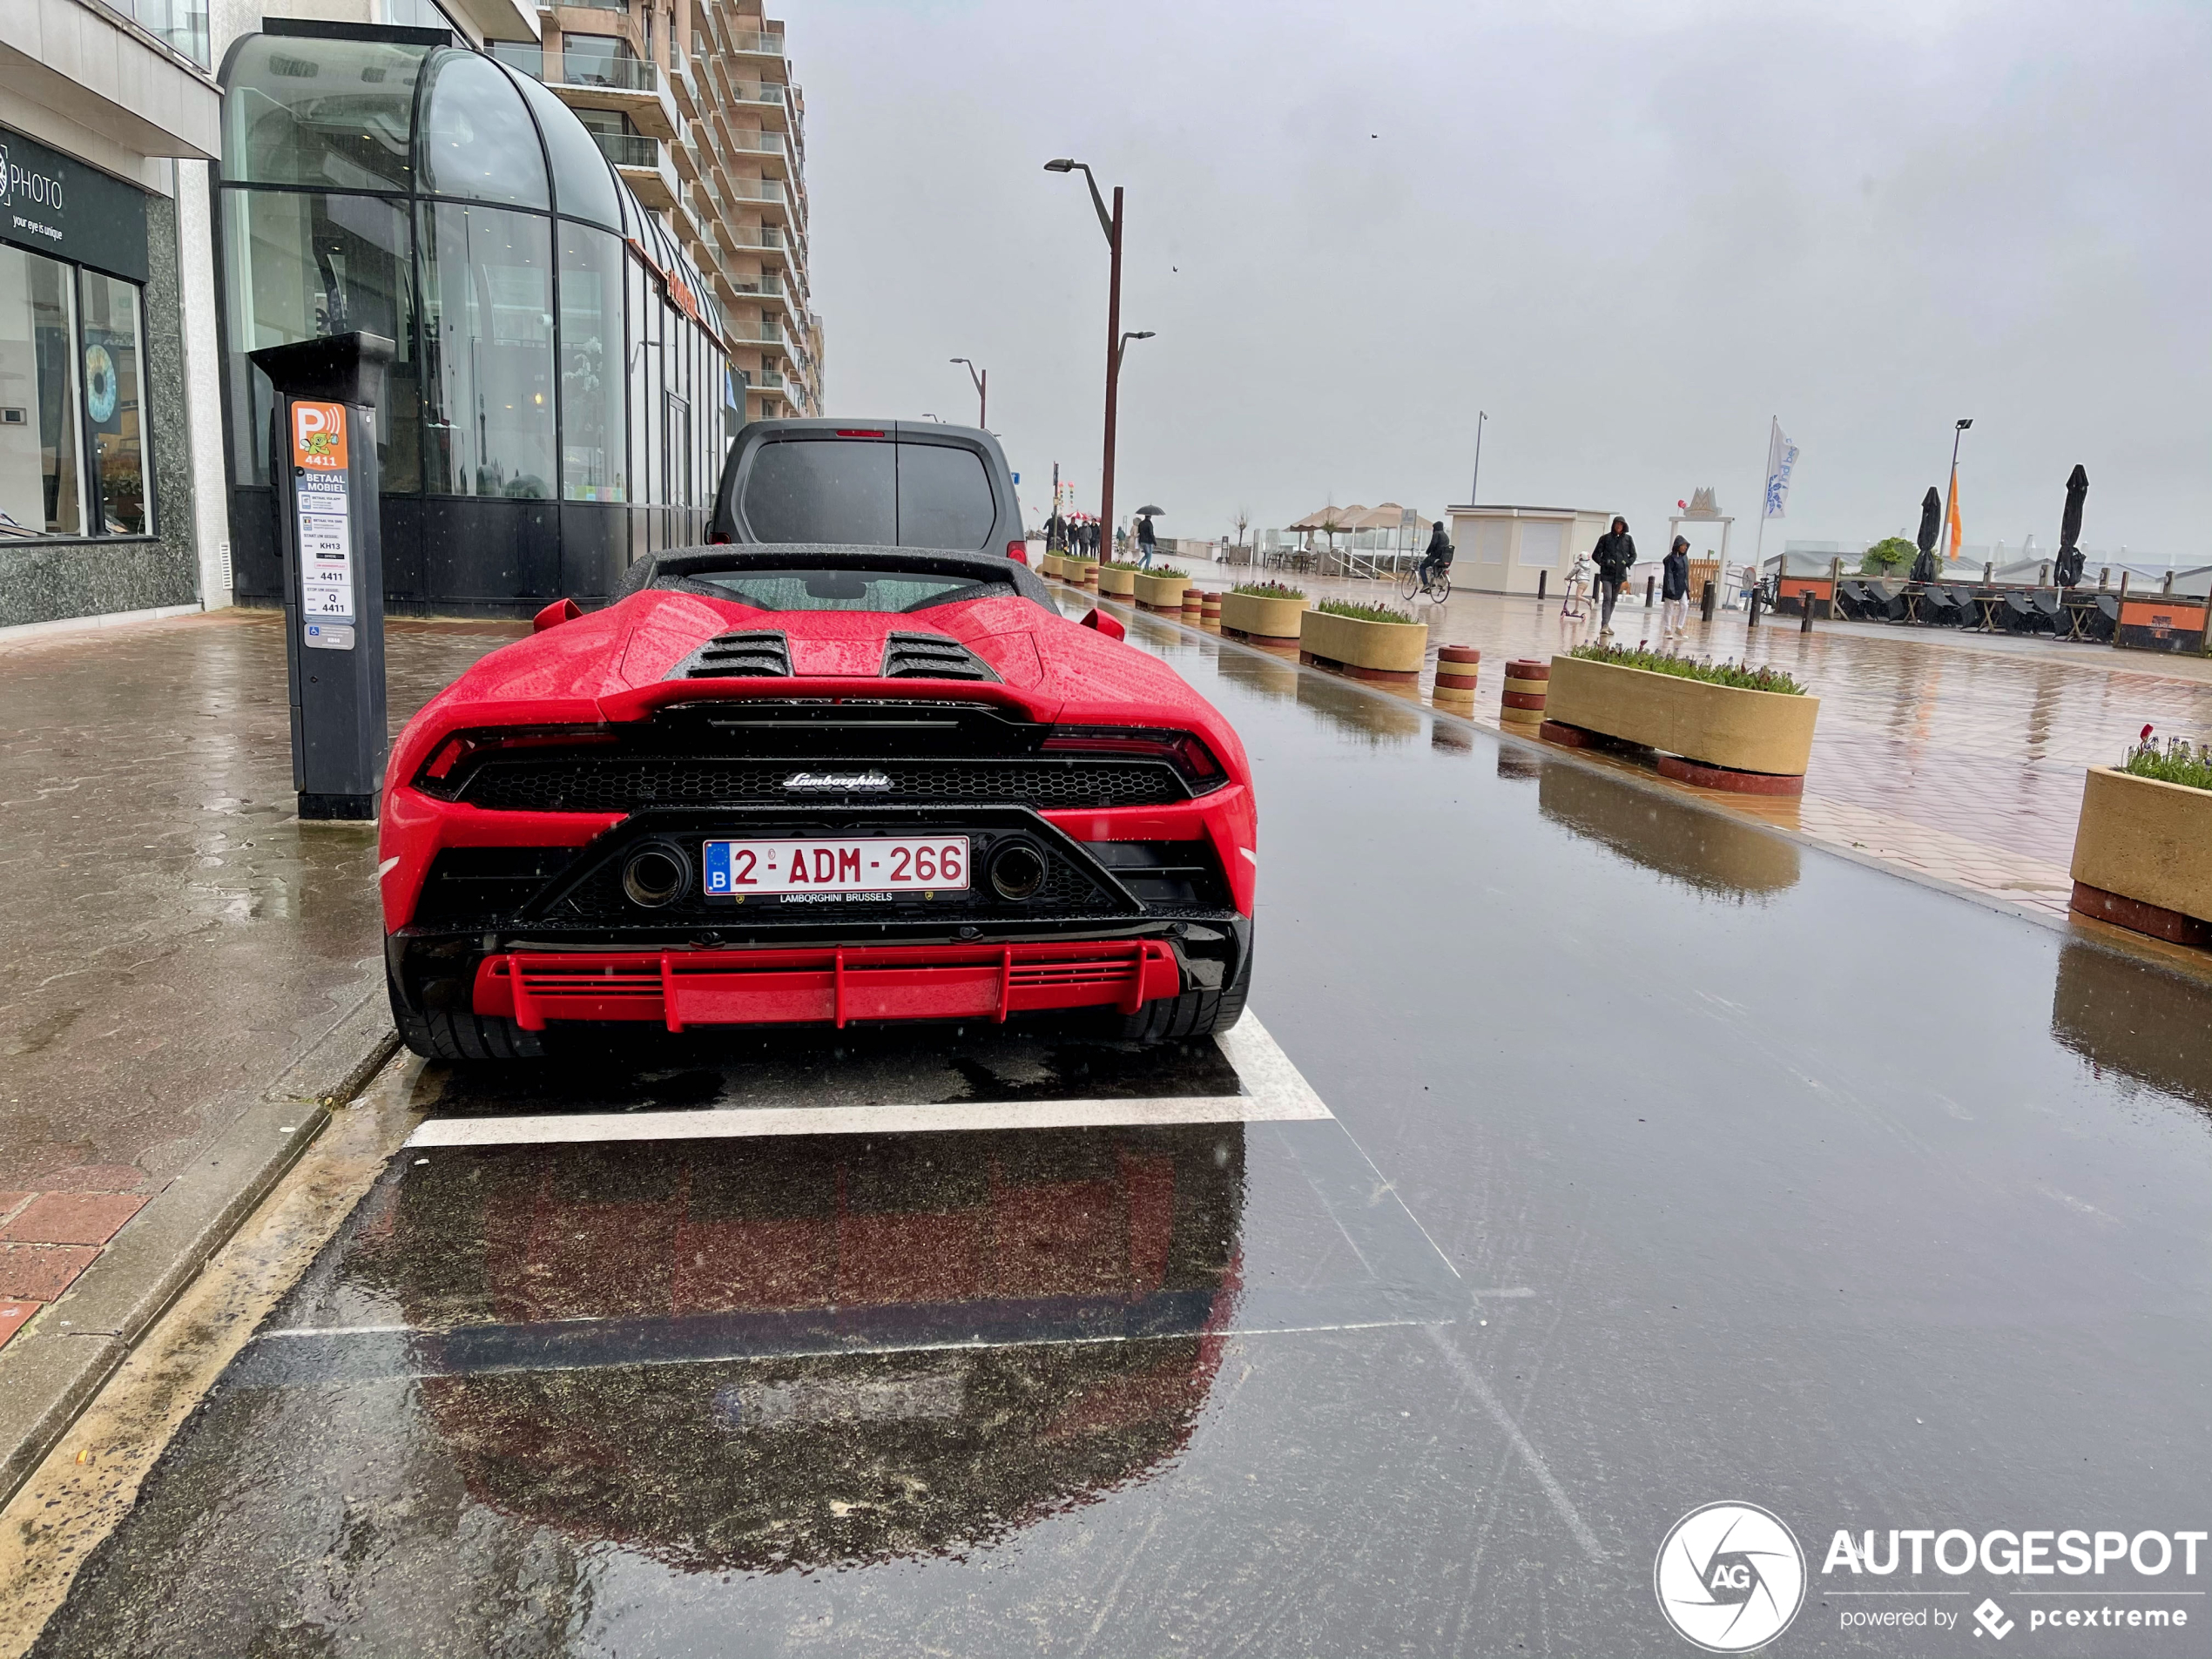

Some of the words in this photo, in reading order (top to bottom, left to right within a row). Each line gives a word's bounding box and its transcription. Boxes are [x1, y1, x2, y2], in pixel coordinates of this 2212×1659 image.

[10, 164, 62, 210] PHOTO
[13, 215, 27, 228] your
[27, 220, 38, 234] eye
[38, 221, 44, 233] is
[44, 226, 63, 242] unique
[297, 408, 326, 449] P
[305, 455, 337, 466] 4411
[306, 473, 346, 484] BETAAL
[307, 482, 346, 493] MOBIEL
[320, 572, 342, 581] 4411
[329, 594, 336, 603] Q
[322, 604, 344, 612] 4411
[783, 772, 887, 788] Lamborghini
[712, 872, 726, 888] B
[780, 894, 841, 904] LAMBORGHINI
[846, 893, 893, 901] BRUSSELS
